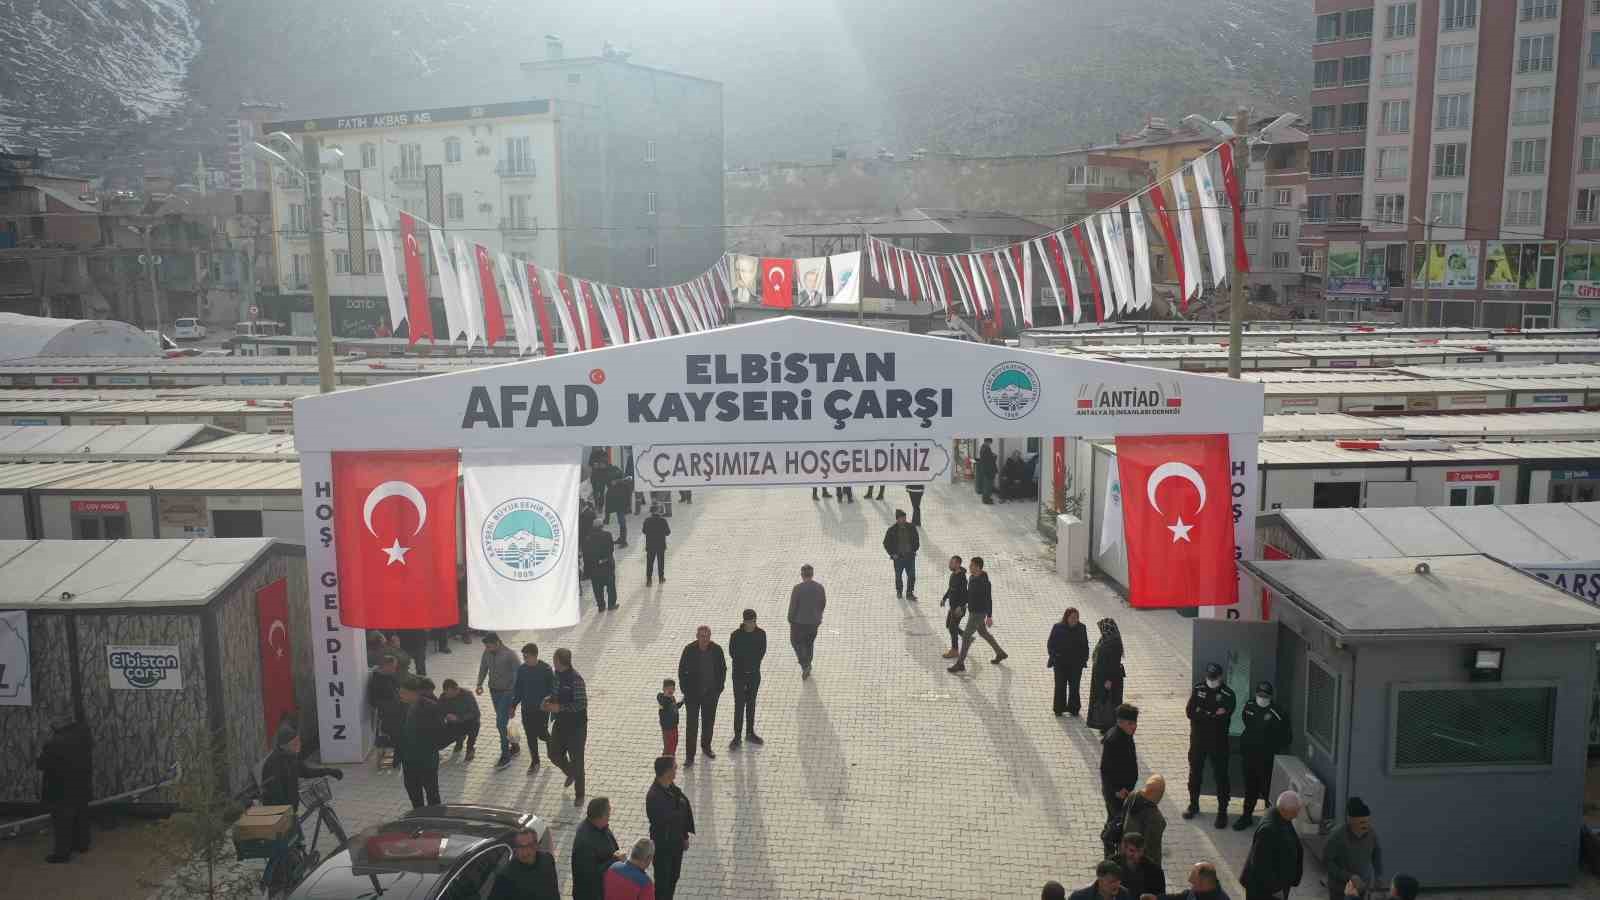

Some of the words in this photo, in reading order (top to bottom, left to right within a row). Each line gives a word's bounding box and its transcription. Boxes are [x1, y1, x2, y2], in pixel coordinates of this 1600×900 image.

[461, 384, 599, 428] AFAD
[823, 387, 953, 430] ÇARŞI
[1099, 387, 1160, 408] ANTİAD
[653, 450, 777, 482] ÇARŞIMIZA
[785, 442, 930, 479] HOŞGELDİNİZ
[315, 482, 333, 547] HOŞ
[110, 652, 177, 668] Elbistan
